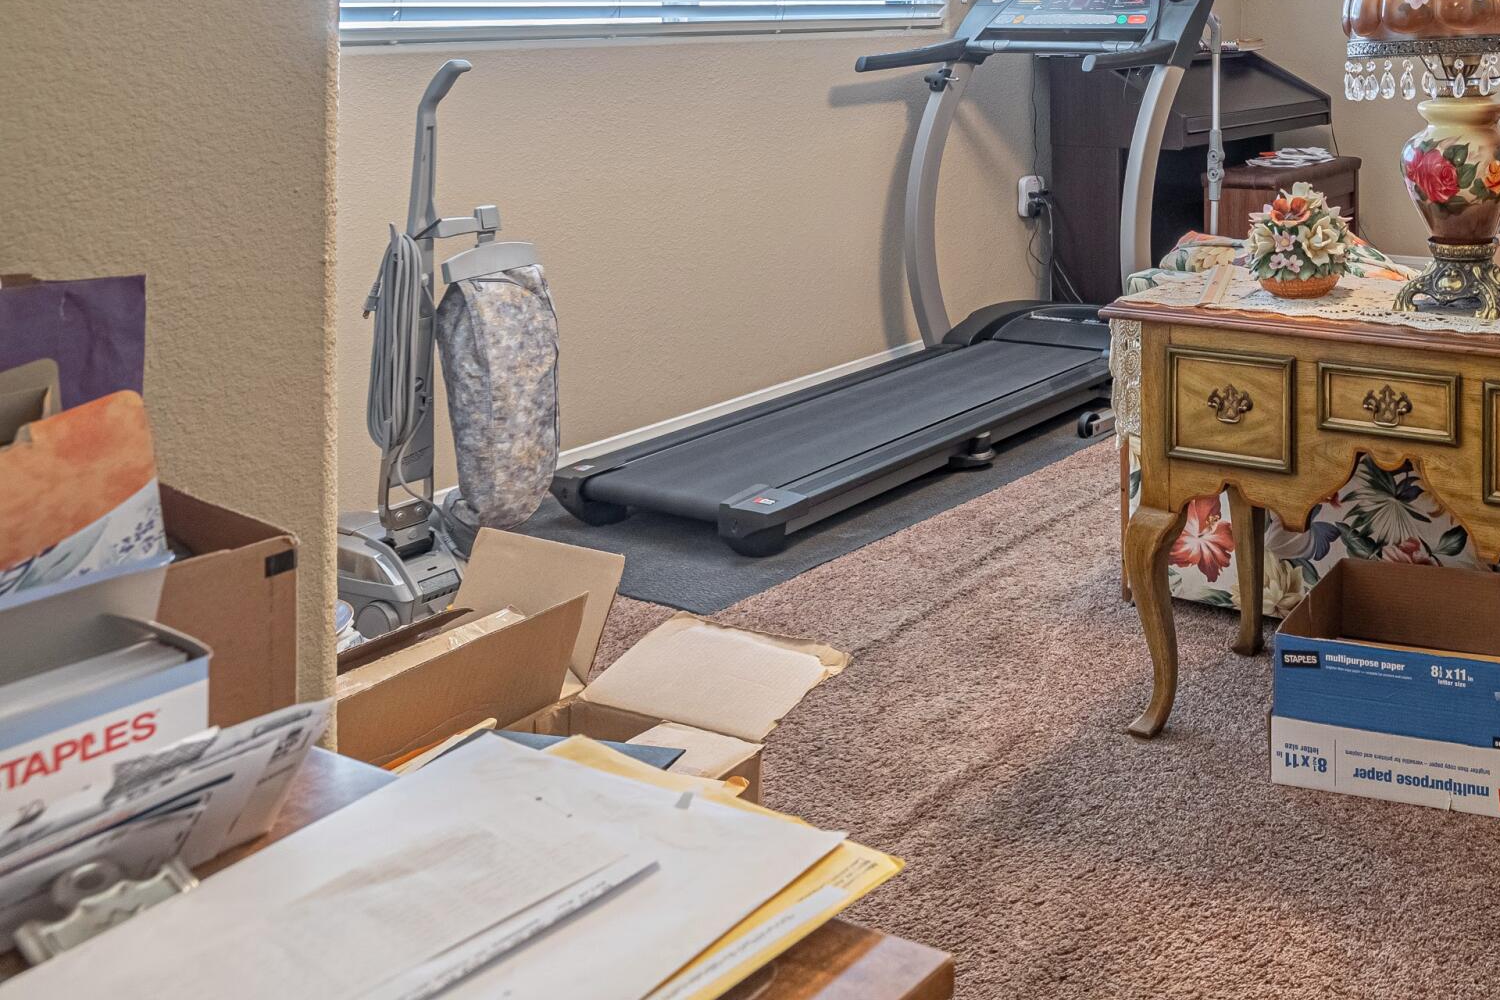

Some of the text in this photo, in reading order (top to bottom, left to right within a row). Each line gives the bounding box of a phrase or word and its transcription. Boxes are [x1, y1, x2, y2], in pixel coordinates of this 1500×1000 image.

[1283, 654, 1318, 665] STAPLES
[1325, 653, 1406, 672] multipurpose paper
[0, 711, 158, 790] TAPLES
[1284, 742, 1319, 755] letter size
[1470, 767, 1490, 776] brighter
[1353, 767, 1490, 797] multipurpose paper
